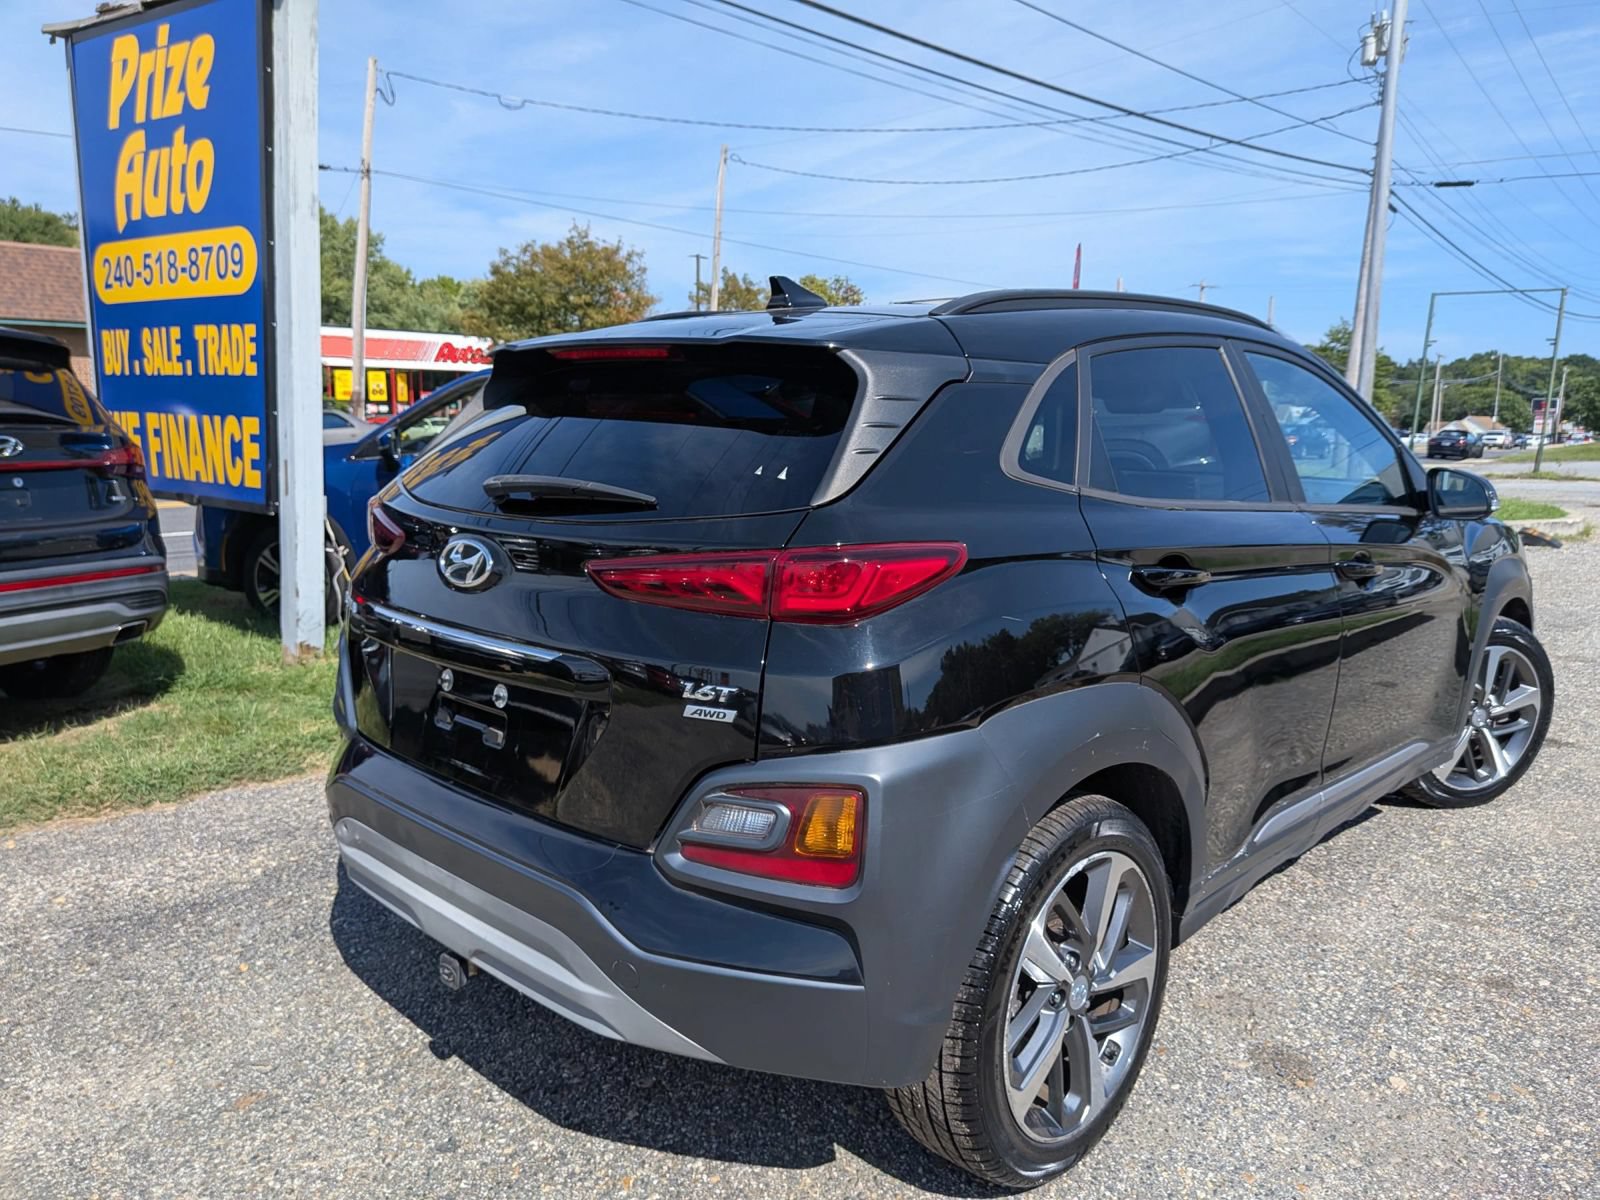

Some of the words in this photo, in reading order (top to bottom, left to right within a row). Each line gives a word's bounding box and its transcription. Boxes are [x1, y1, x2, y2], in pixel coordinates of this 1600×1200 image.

[108, 24, 215, 129] Prize
[115, 125, 215, 235] Auto
[102, 242, 244, 290] 240-518-8709
[101, 329, 130, 376] BUY
[141, 326, 183, 376] SALE
[194, 323, 258, 377] TRADE
[145, 411, 262, 489] FINANCE
[691, 708, 727, 719] AWD
